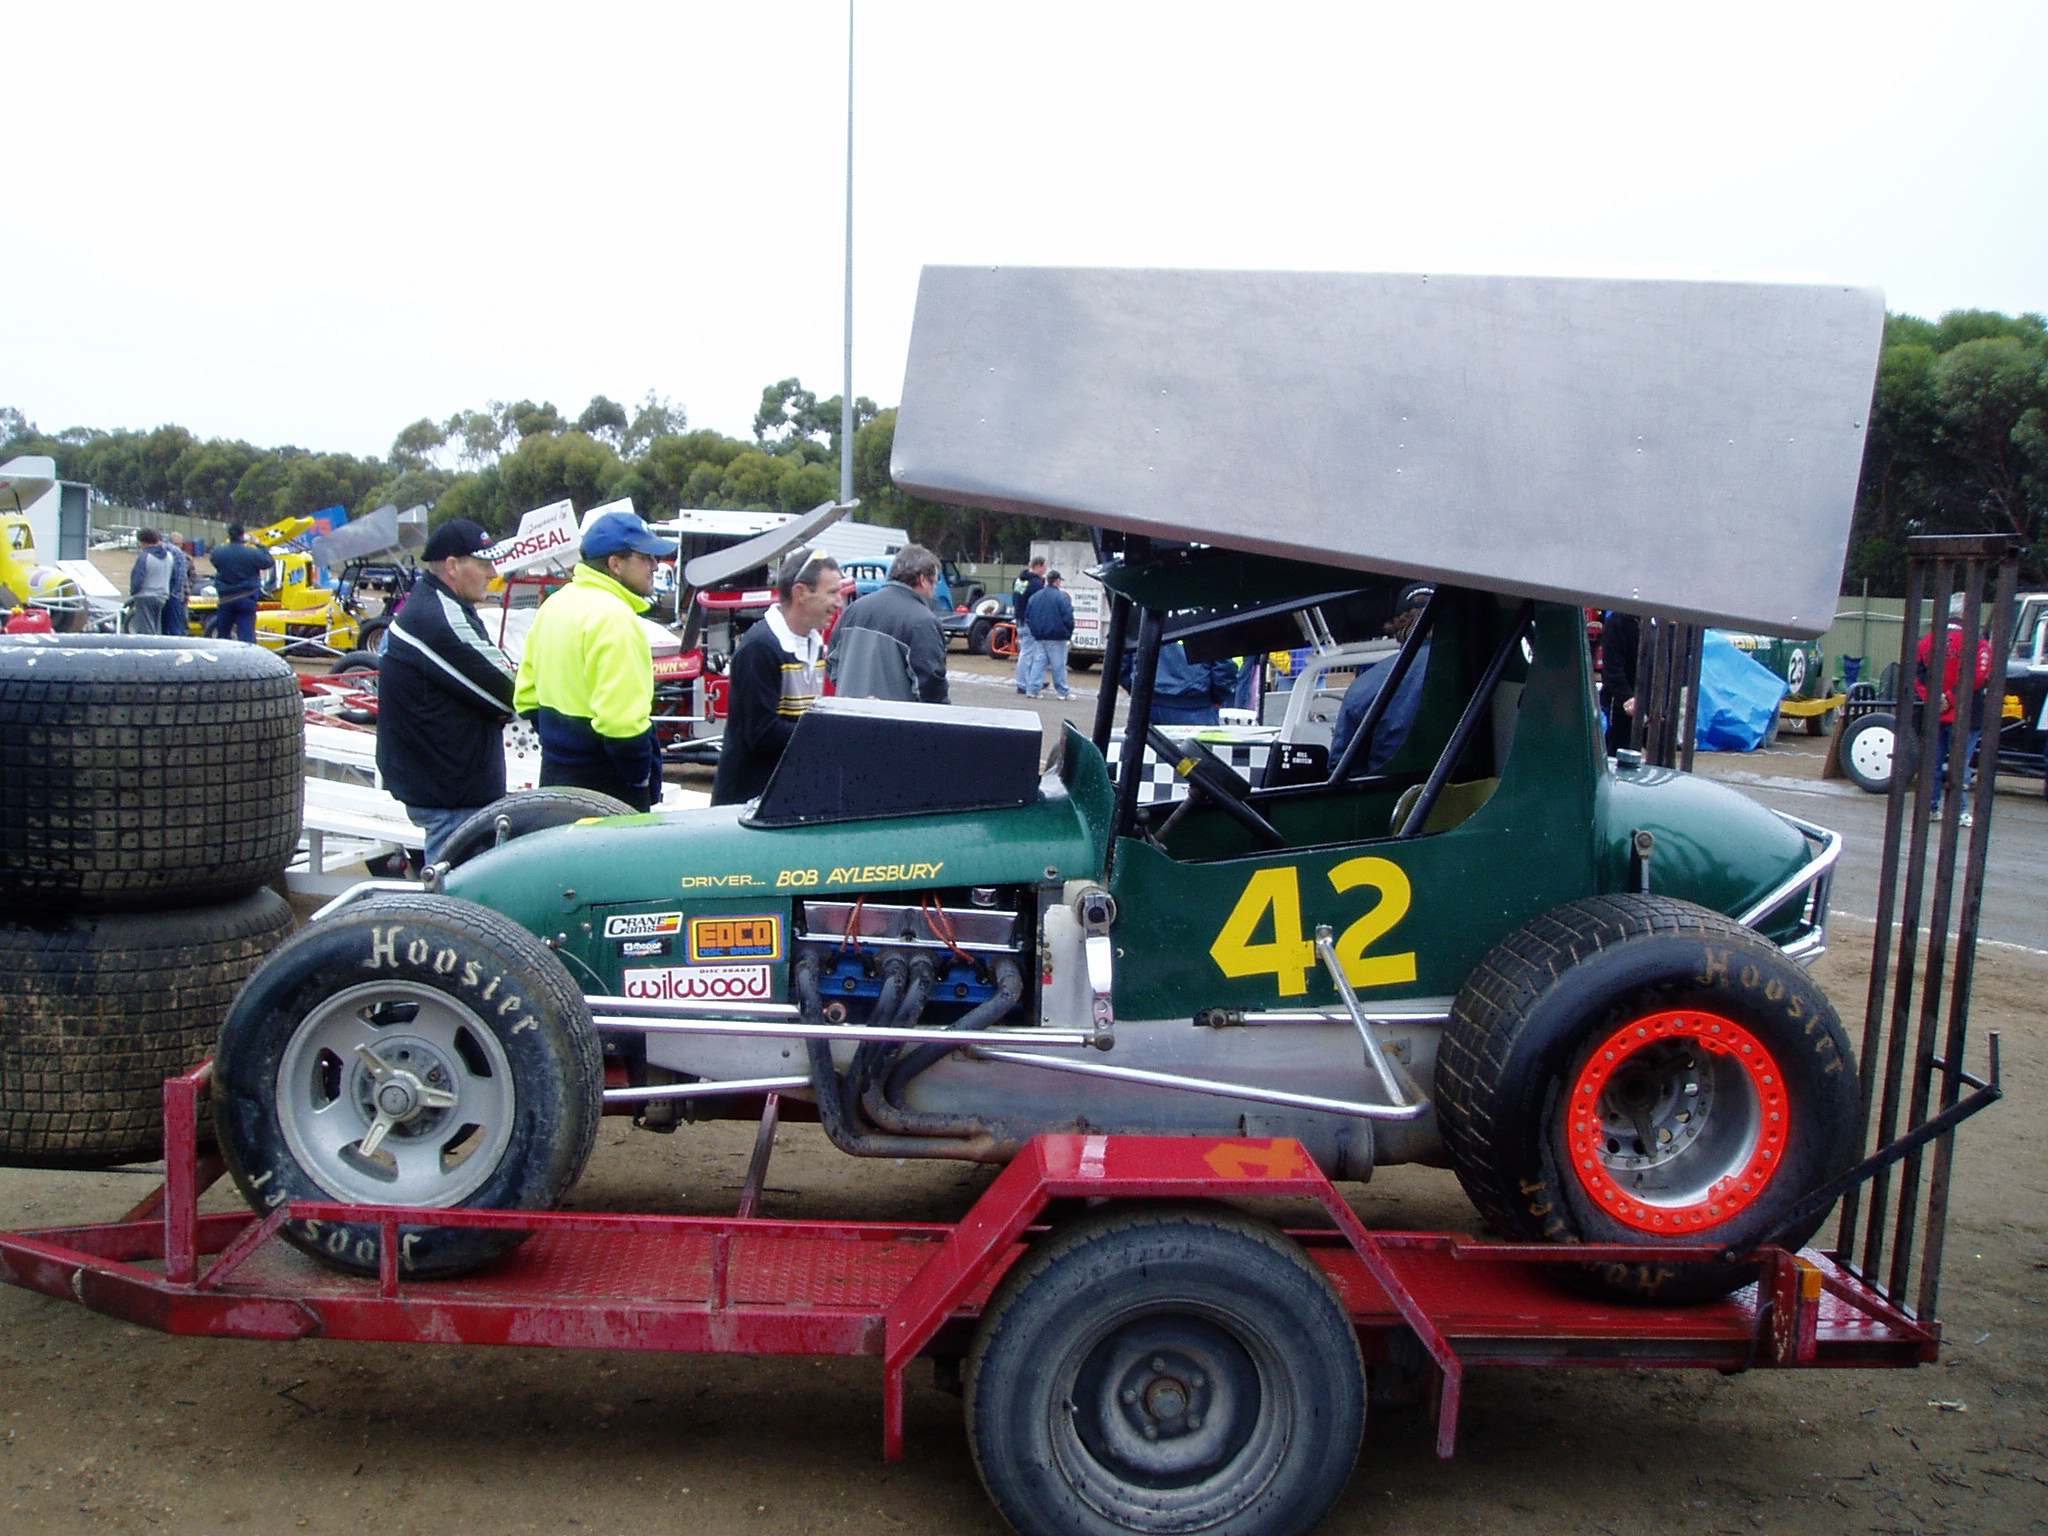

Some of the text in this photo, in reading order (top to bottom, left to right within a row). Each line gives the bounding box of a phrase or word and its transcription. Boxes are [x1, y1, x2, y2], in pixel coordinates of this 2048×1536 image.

[776, 869, 819, 887] BOB
[826, 862, 944, 884] AYLESBURY
[698, 921, 772, 948] EDCO
[1209, 857, 1417, 996] 42
[362, 924, 540, 1034] Hoosier
[628, 968, 767, 999] wilwood
